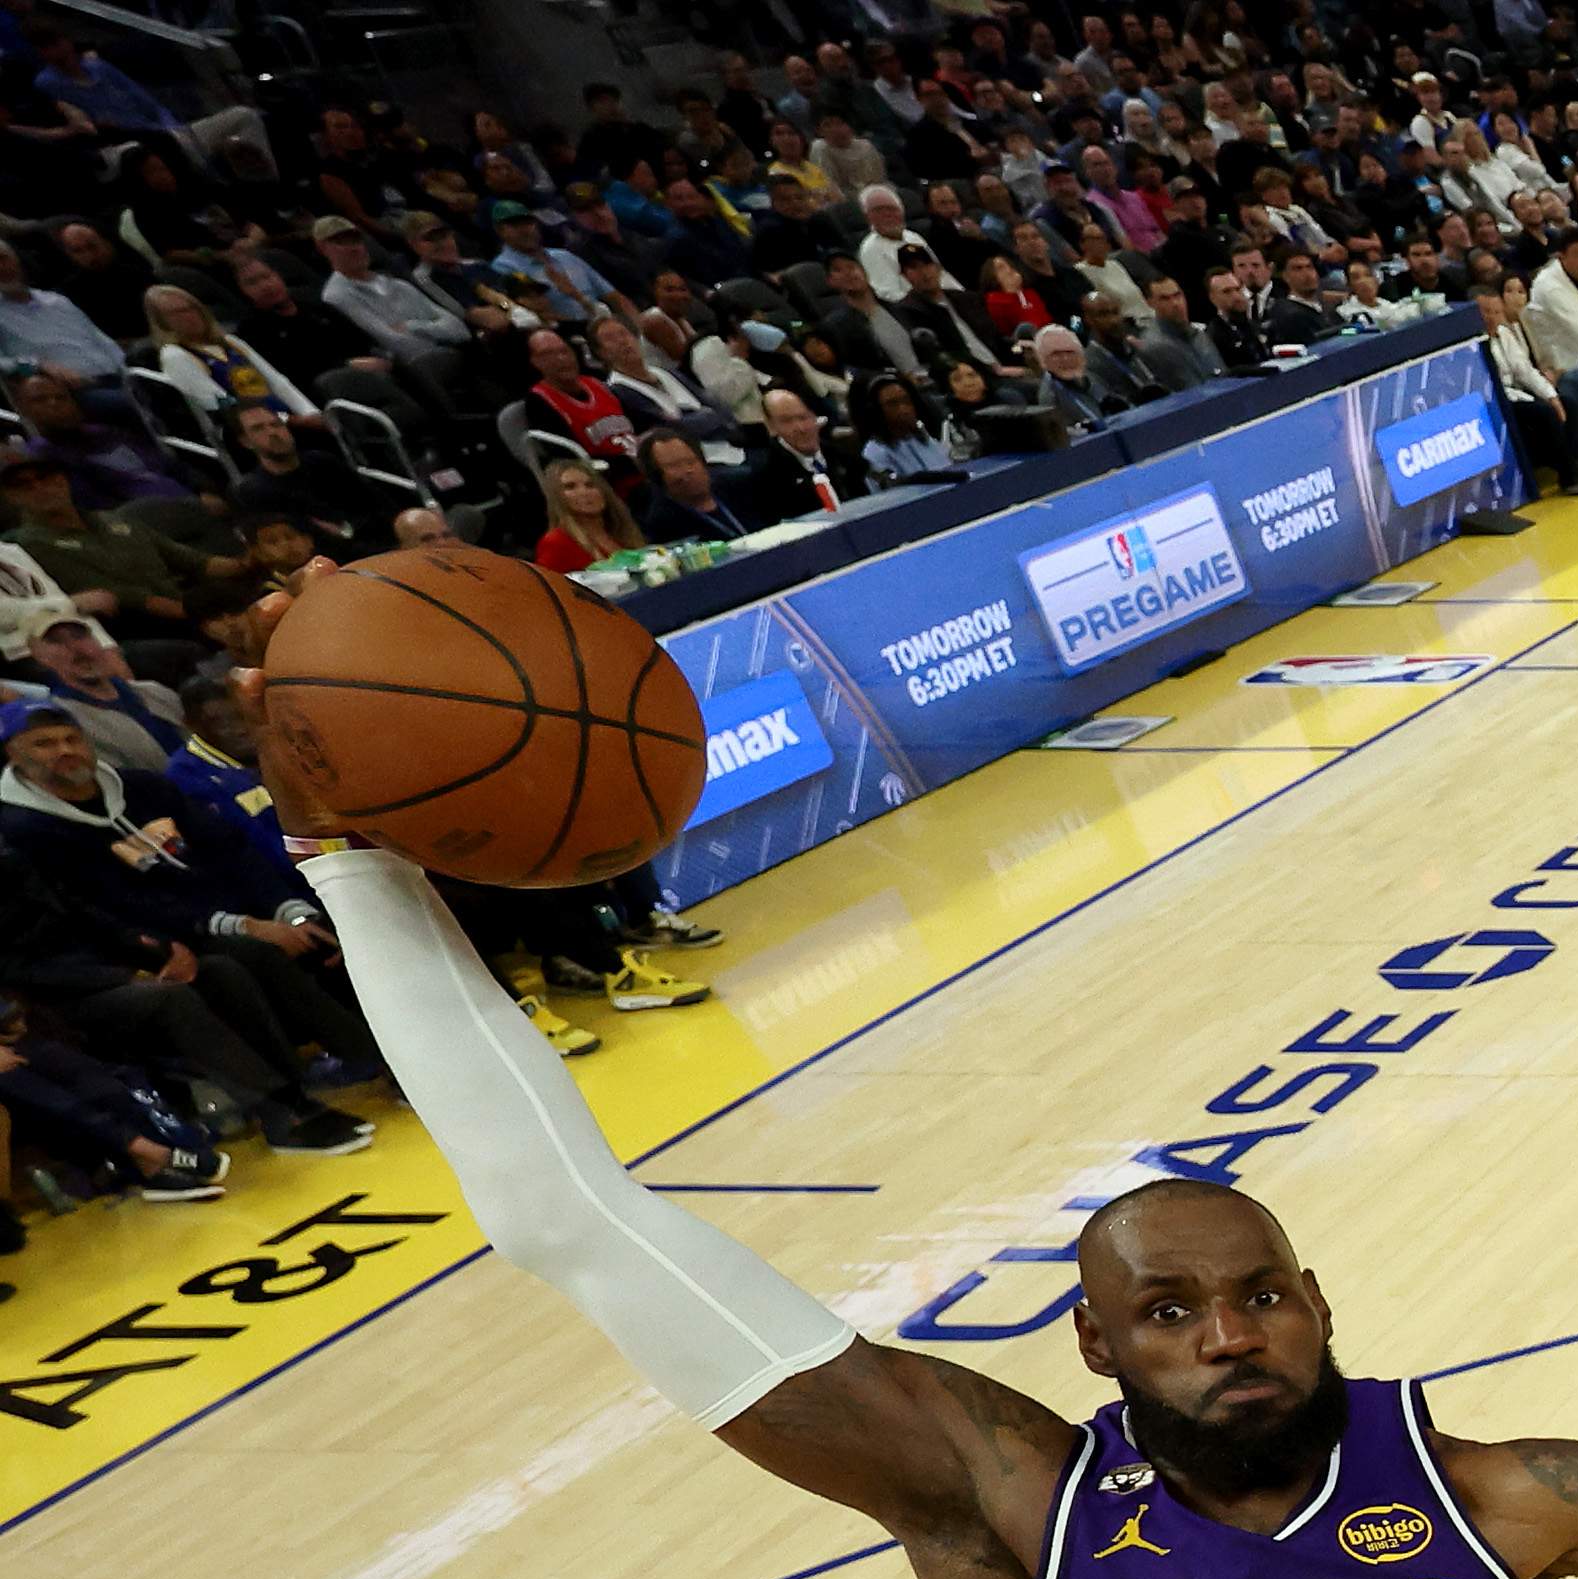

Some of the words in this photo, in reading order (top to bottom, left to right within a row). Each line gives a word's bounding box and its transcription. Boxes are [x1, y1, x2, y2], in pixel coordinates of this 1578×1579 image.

[1242, 466, 1336, 525] TOMORROW
[879, 598, 1012, 677] TOMORROW
[1058, 551, 1236, 652] PREGAME
[0, 1192, 452, 1430] AT&T
[1345, 1519, 1425, 1545] bibigo
